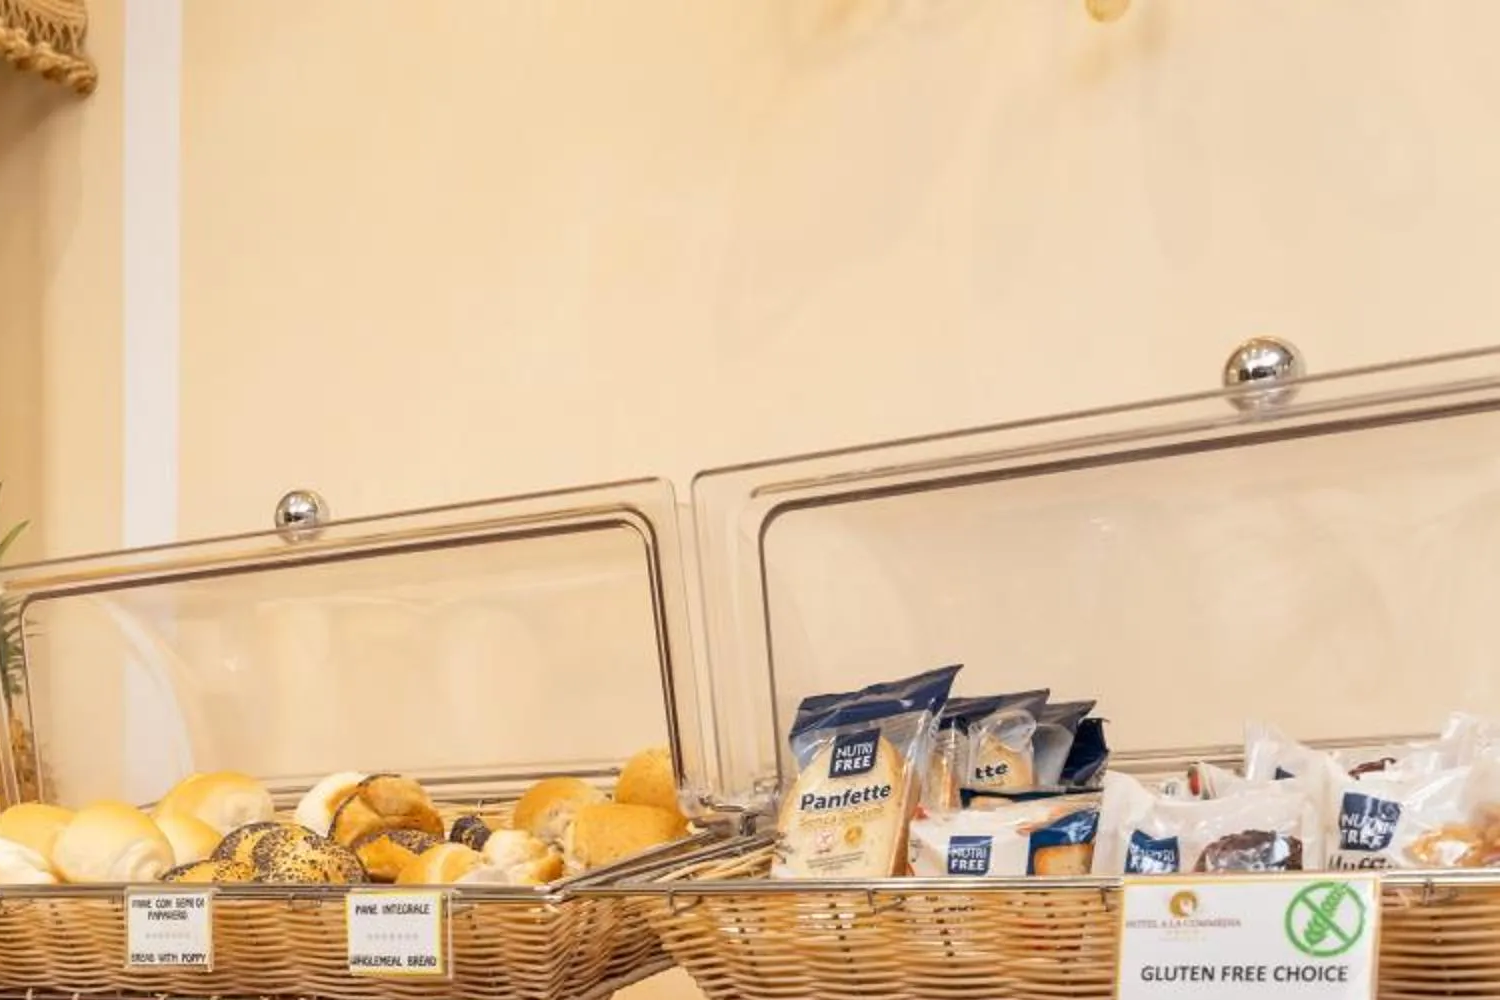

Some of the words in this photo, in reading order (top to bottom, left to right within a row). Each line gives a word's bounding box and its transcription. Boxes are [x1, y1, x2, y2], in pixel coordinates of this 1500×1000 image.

[836, 742, 873, 759] NUTRI
[834, 756, 871, 773] FREE
[975, 763, 1009, 779] tte
[800, 784, 891, 811] Panfette
[951, 859, 986, 871] FREE
[1140, 965, 1215, 982] GLUTEN
[1220, 965, 1267, 983] FREE
[1273, 965, 1349, 983] CHOICE
